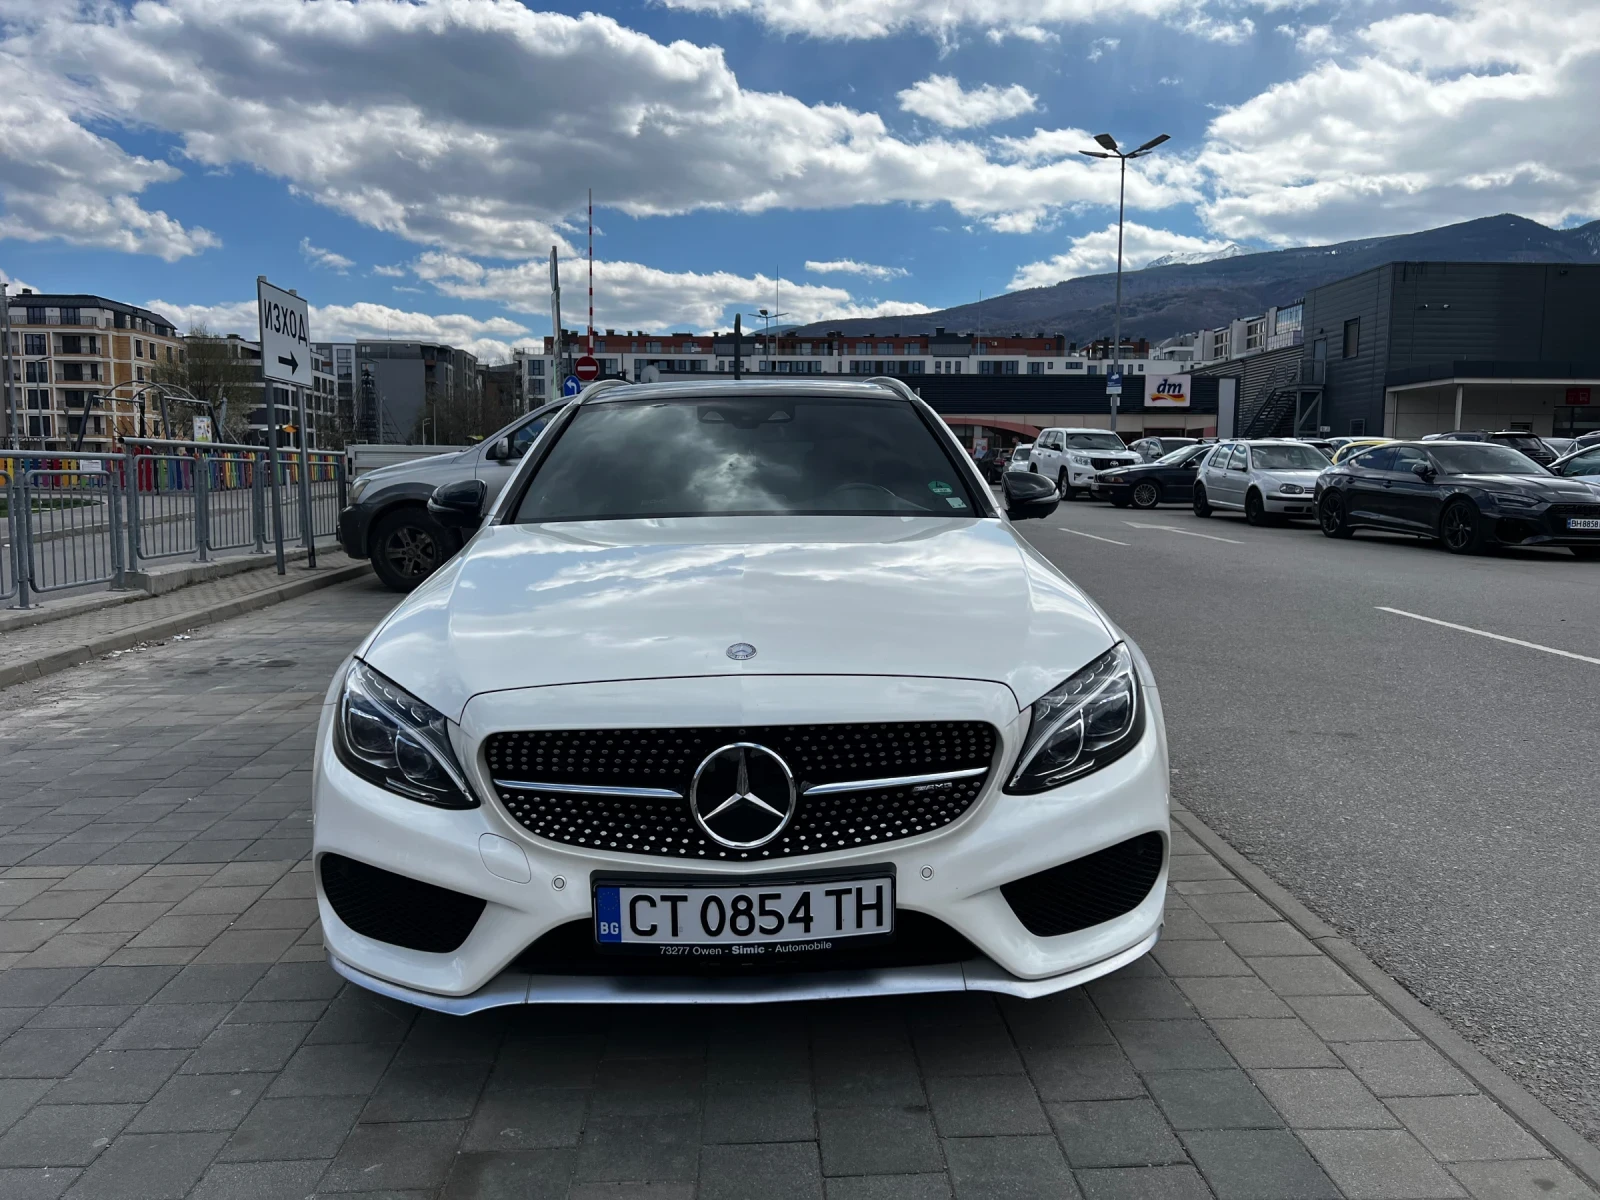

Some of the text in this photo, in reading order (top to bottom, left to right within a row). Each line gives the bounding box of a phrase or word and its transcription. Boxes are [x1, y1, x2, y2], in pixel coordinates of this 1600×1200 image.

[264, 298, 308, 347] ИЗХОД
[1156, 377, 1182, 394] dm
[600, 885, 883, 938] BG CT 0854 TH
[659, 946, 690, 955] 73277
[692, 946, 722, 955] Owen
[731, 945, 765, 954] Simic
[775, 941, 832, 953] Automobile
